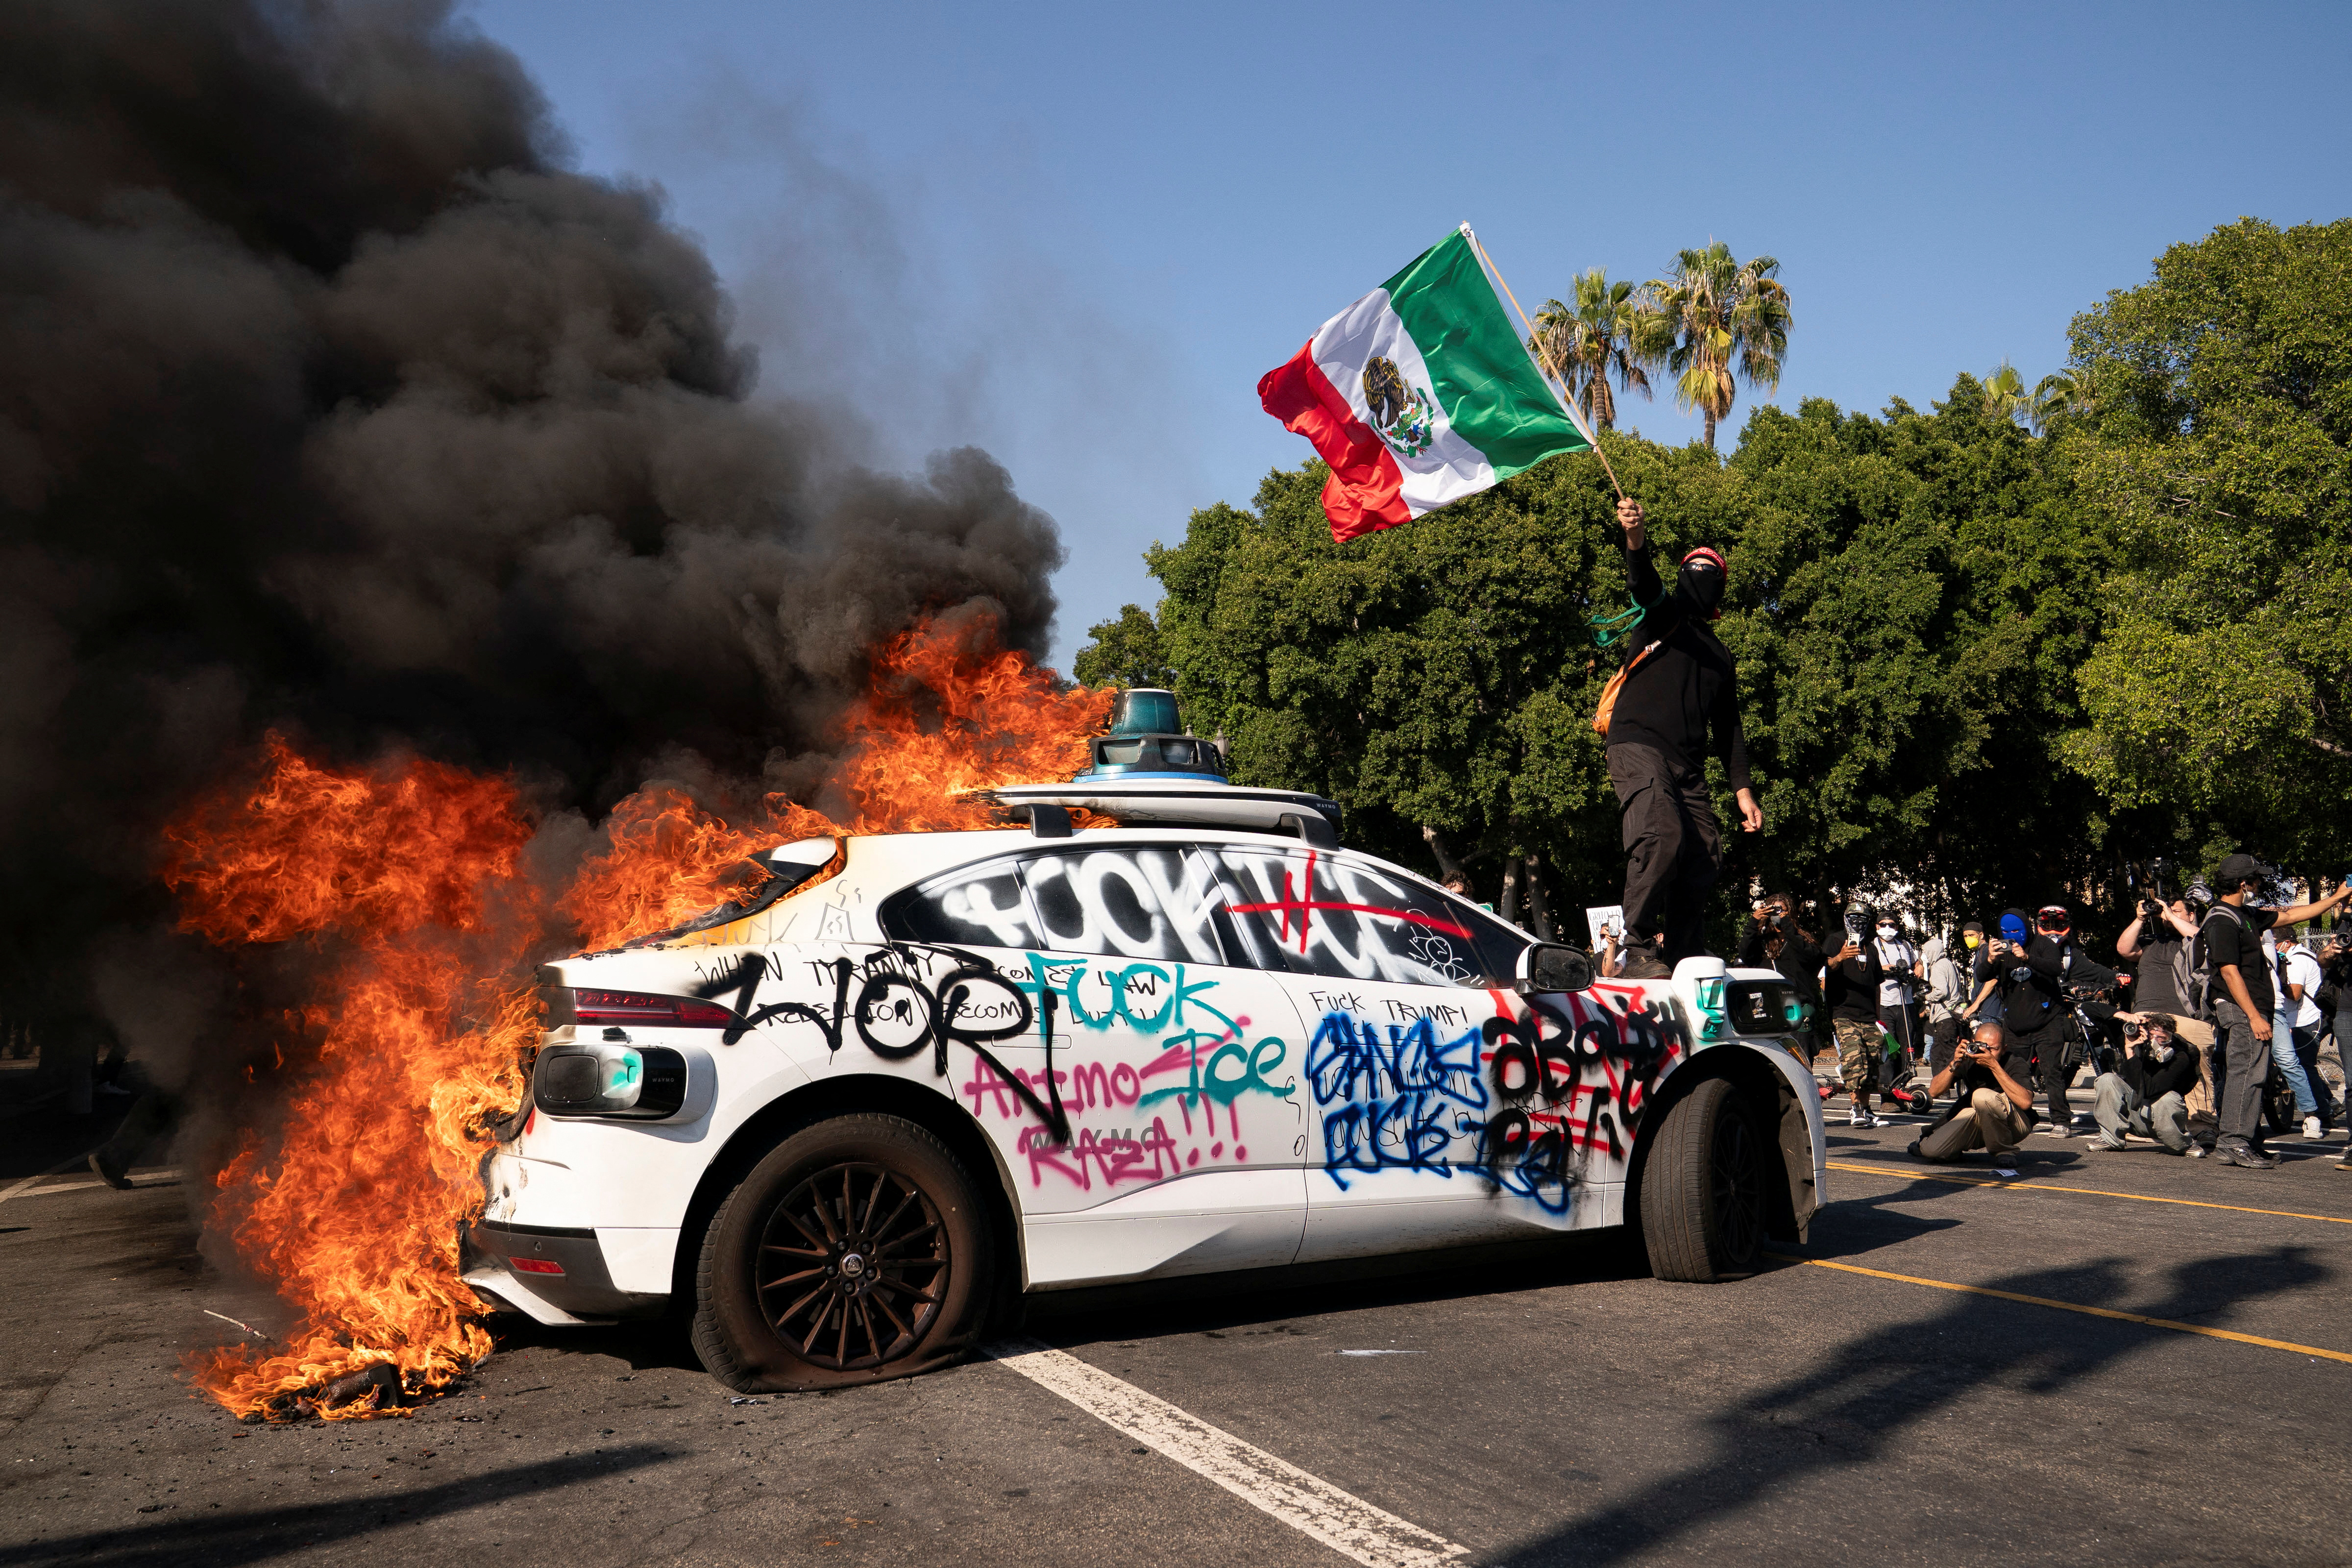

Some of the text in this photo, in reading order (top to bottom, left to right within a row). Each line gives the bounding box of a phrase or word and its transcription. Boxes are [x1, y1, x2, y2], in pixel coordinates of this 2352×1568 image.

[1014, 952, 1243, 1046] FUCK
[1309, 991, 1469, 1030] FUCK TRUMP!
